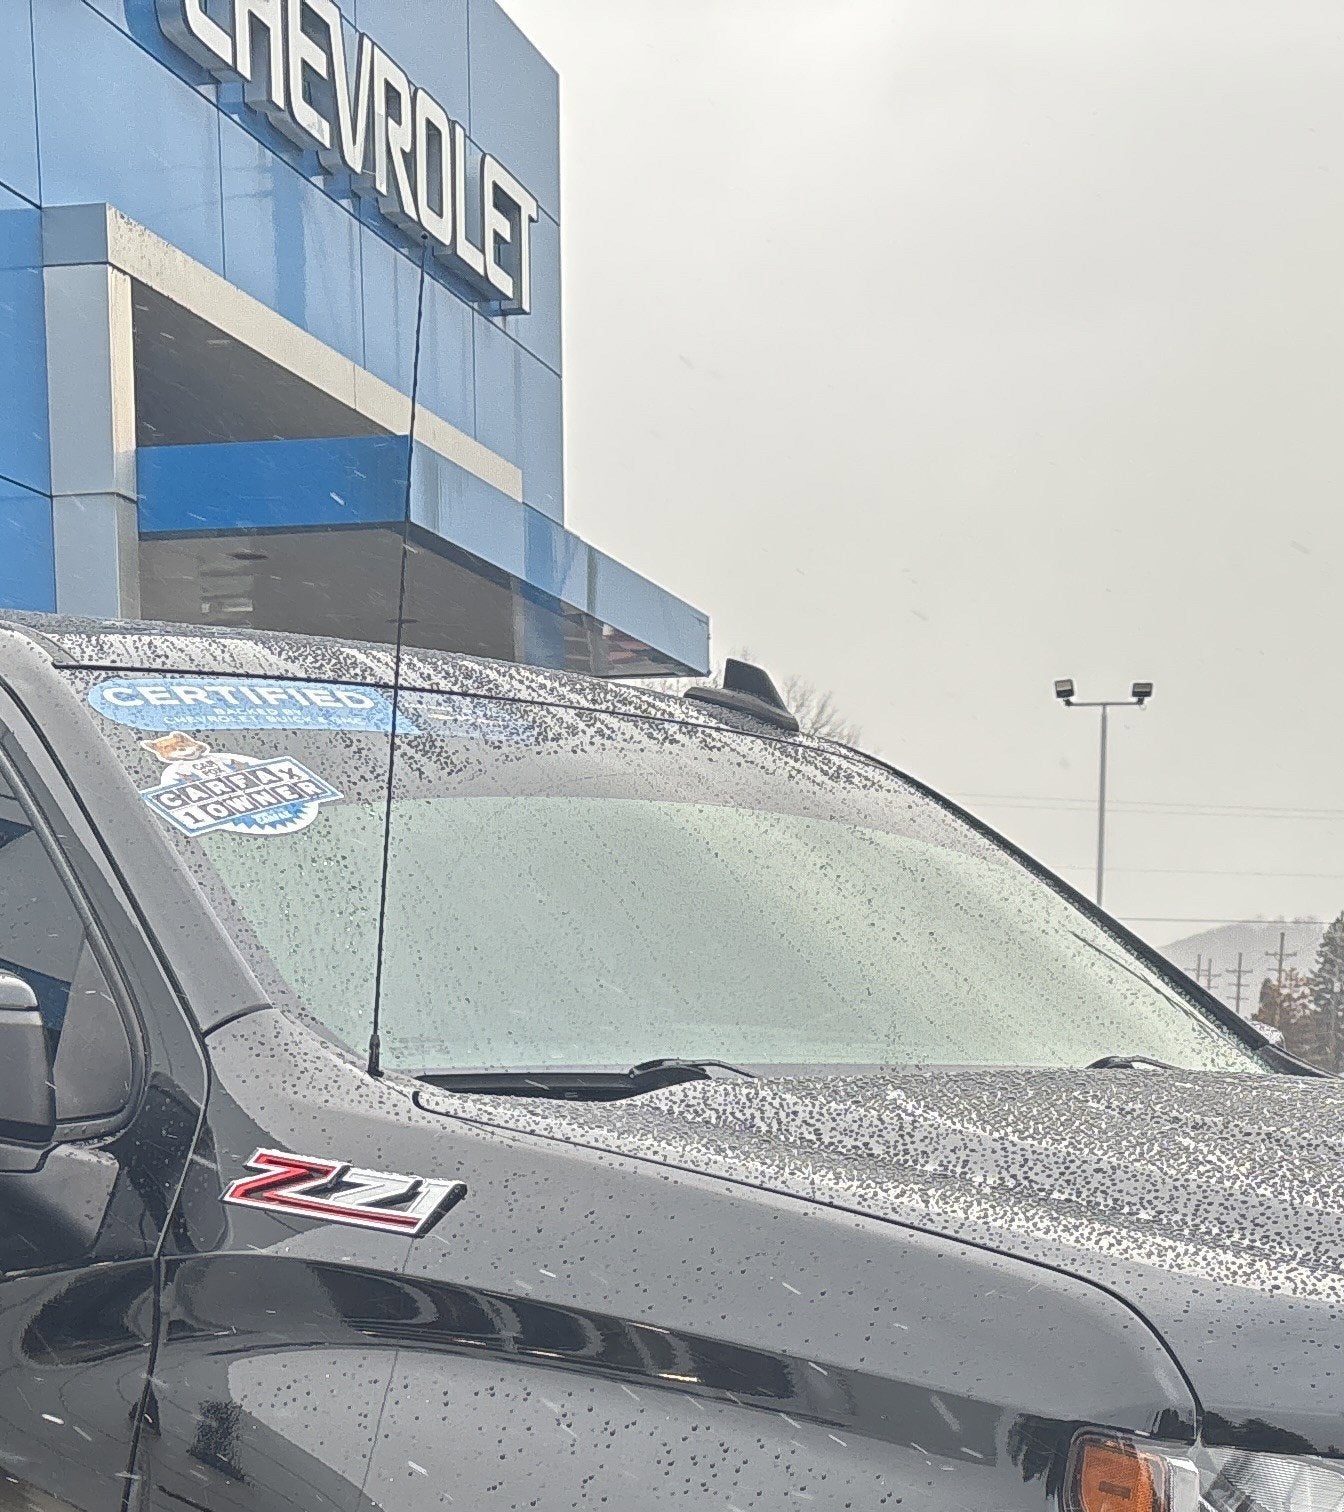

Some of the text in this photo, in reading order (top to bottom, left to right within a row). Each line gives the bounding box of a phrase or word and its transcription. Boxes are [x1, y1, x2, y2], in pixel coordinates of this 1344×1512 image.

[102, 685, 377, 710] CERTIFIED
[163, 715, 259, 726] CHEVROLET
[158, 766, 303, 808] CARFAX
[206, 780, 324, 819] OWNER
[219, 1147, 468, 1238] Z71
